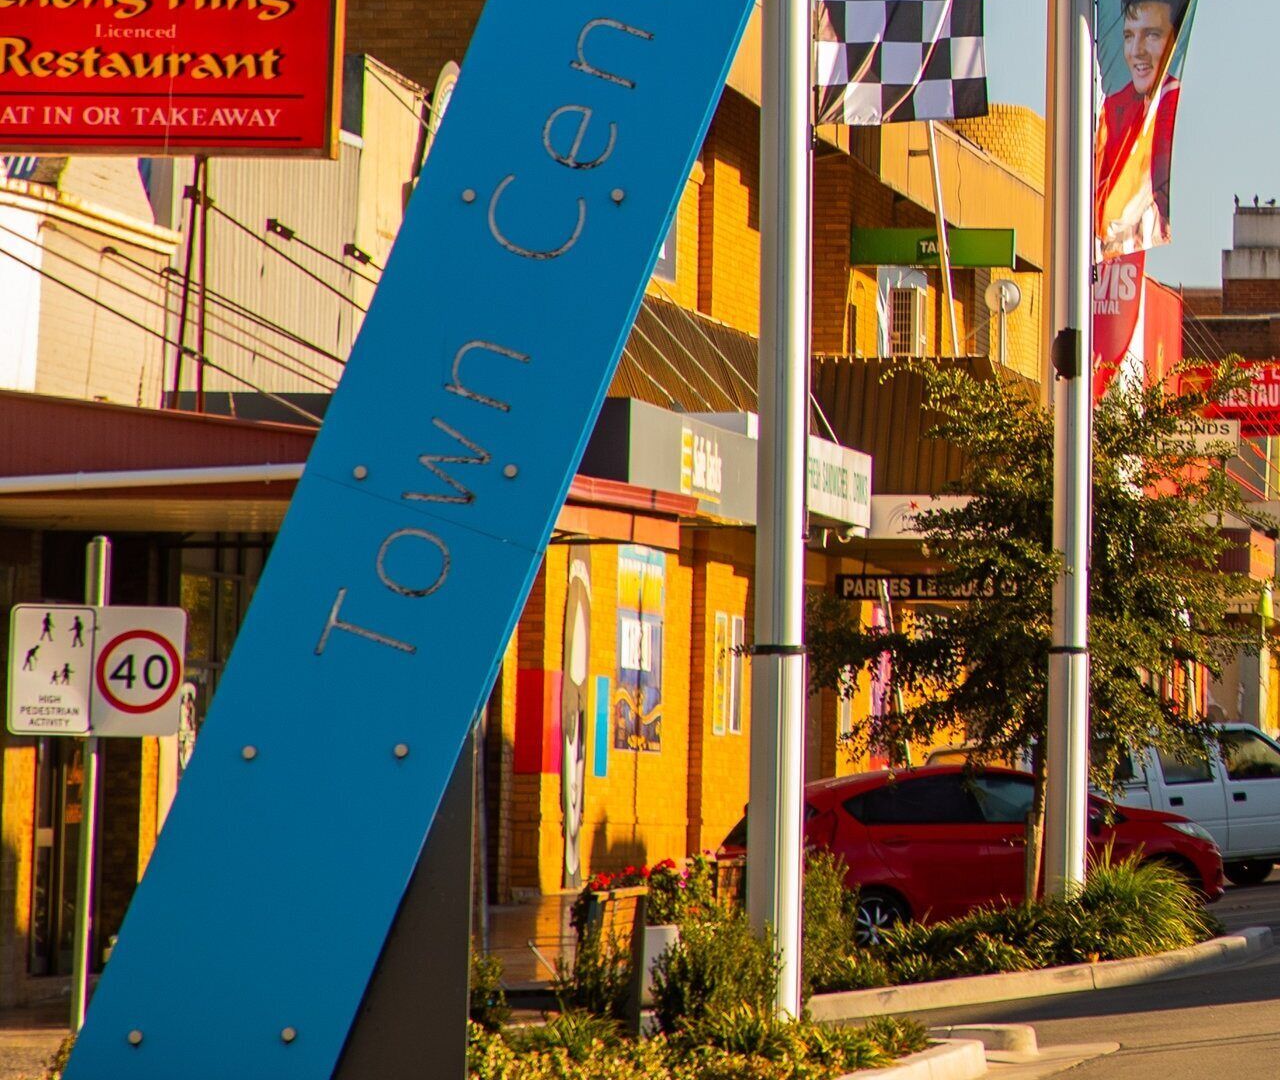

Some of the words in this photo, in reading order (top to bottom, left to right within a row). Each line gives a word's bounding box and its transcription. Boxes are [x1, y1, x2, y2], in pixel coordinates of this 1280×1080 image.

[95, 23, 177, 39] Licenced
[0, 35, 283, 80] Restaurant
[1, 105, 35, 125] AT
[42, 106, 74, 125] IN
[82, 106, 121, 126] OR
[130, 106, 282, 128] TAKEAWAY
[1094, 262, 1138, 301] VIS
[1093, 300, 1121, 315] TIVAL
[314, 340, 532, 656] Town
[842, 577, 912, 598] PARES
[108, 653, 170, 691] 40
[38, 695, 62, 704] HIGH
[20, 706, 80, 716] PEDESTRIAN
[29, 718, 71, 727] ACTIVITY
